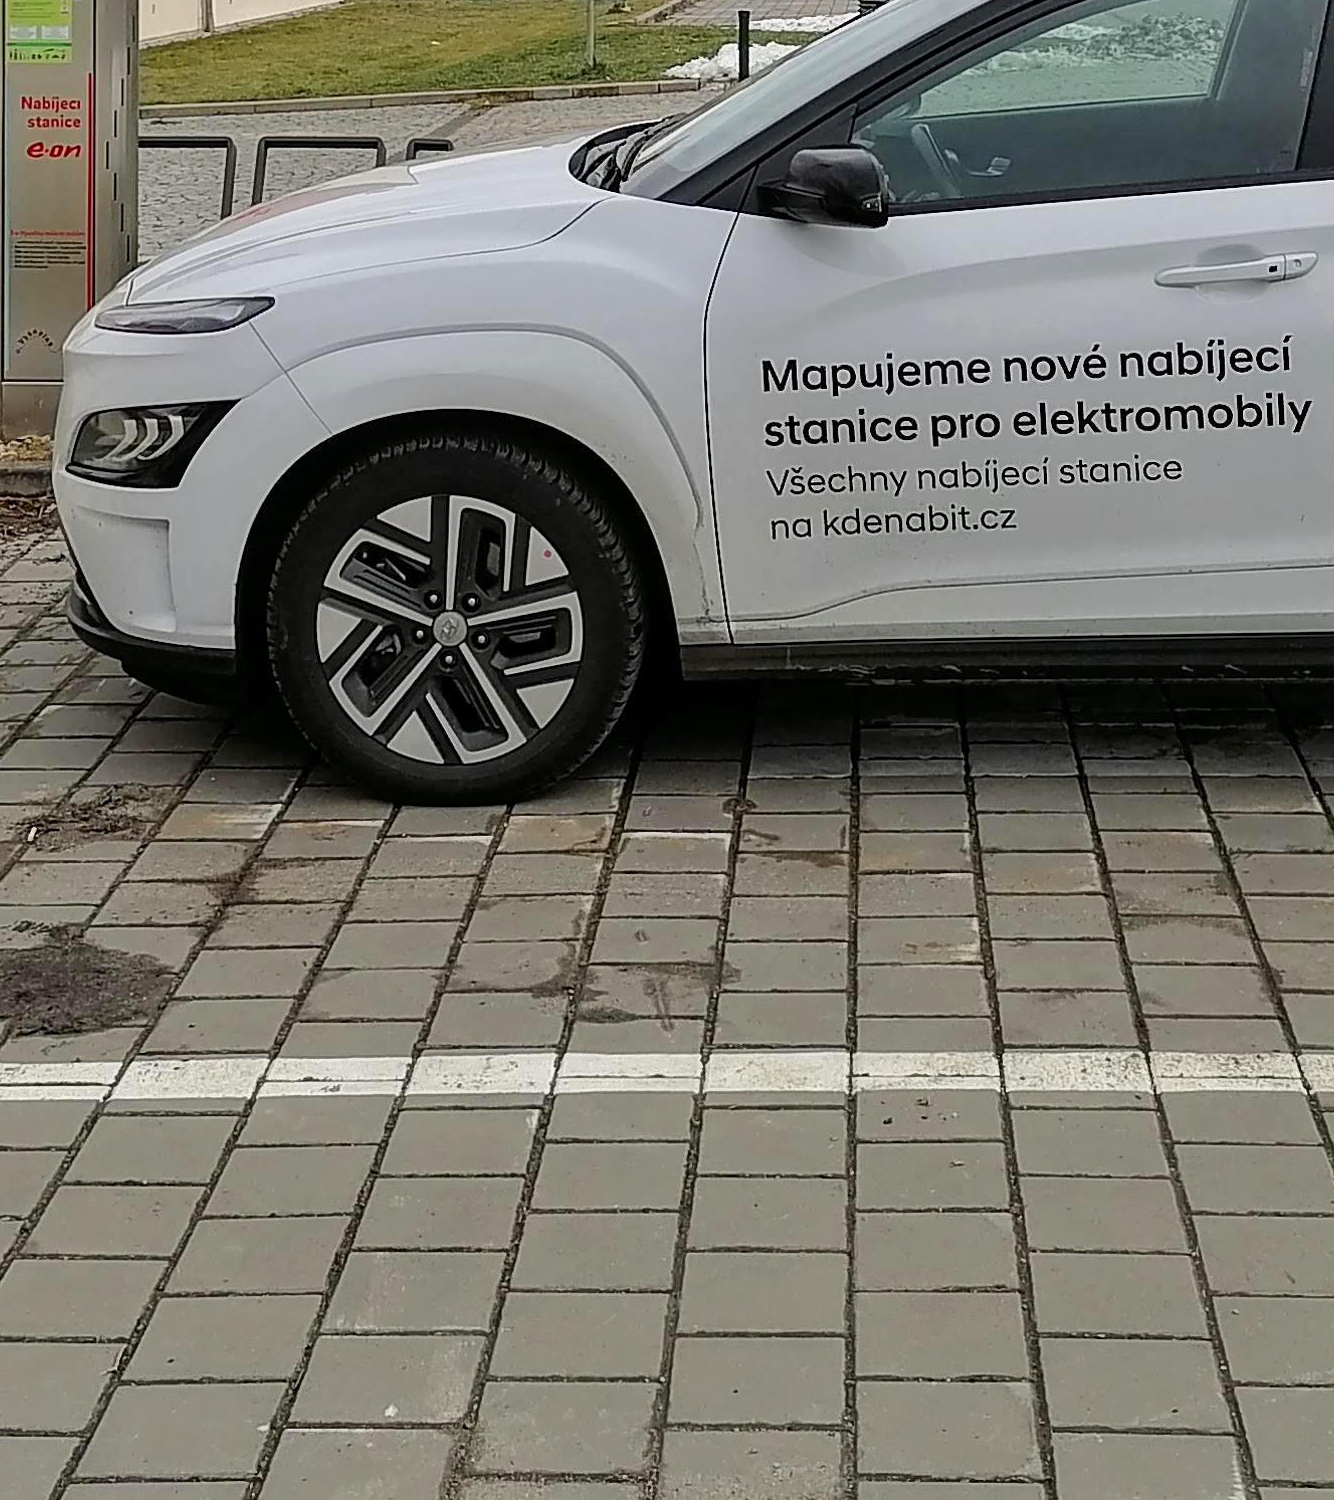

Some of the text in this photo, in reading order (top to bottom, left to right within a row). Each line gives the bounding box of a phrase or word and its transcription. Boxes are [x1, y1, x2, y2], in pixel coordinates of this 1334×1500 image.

[27, 114, 81, 128] stanice
[762, 335, 1291, 396] Mapujeme nové nabíjecí
[765, 393, 1312, 447] stanice pro elektromobily
[766, 455, 1182, 497] Všechny nabíjecí stanice
[771, 504, 1016, 539] na kdenabit.cz
